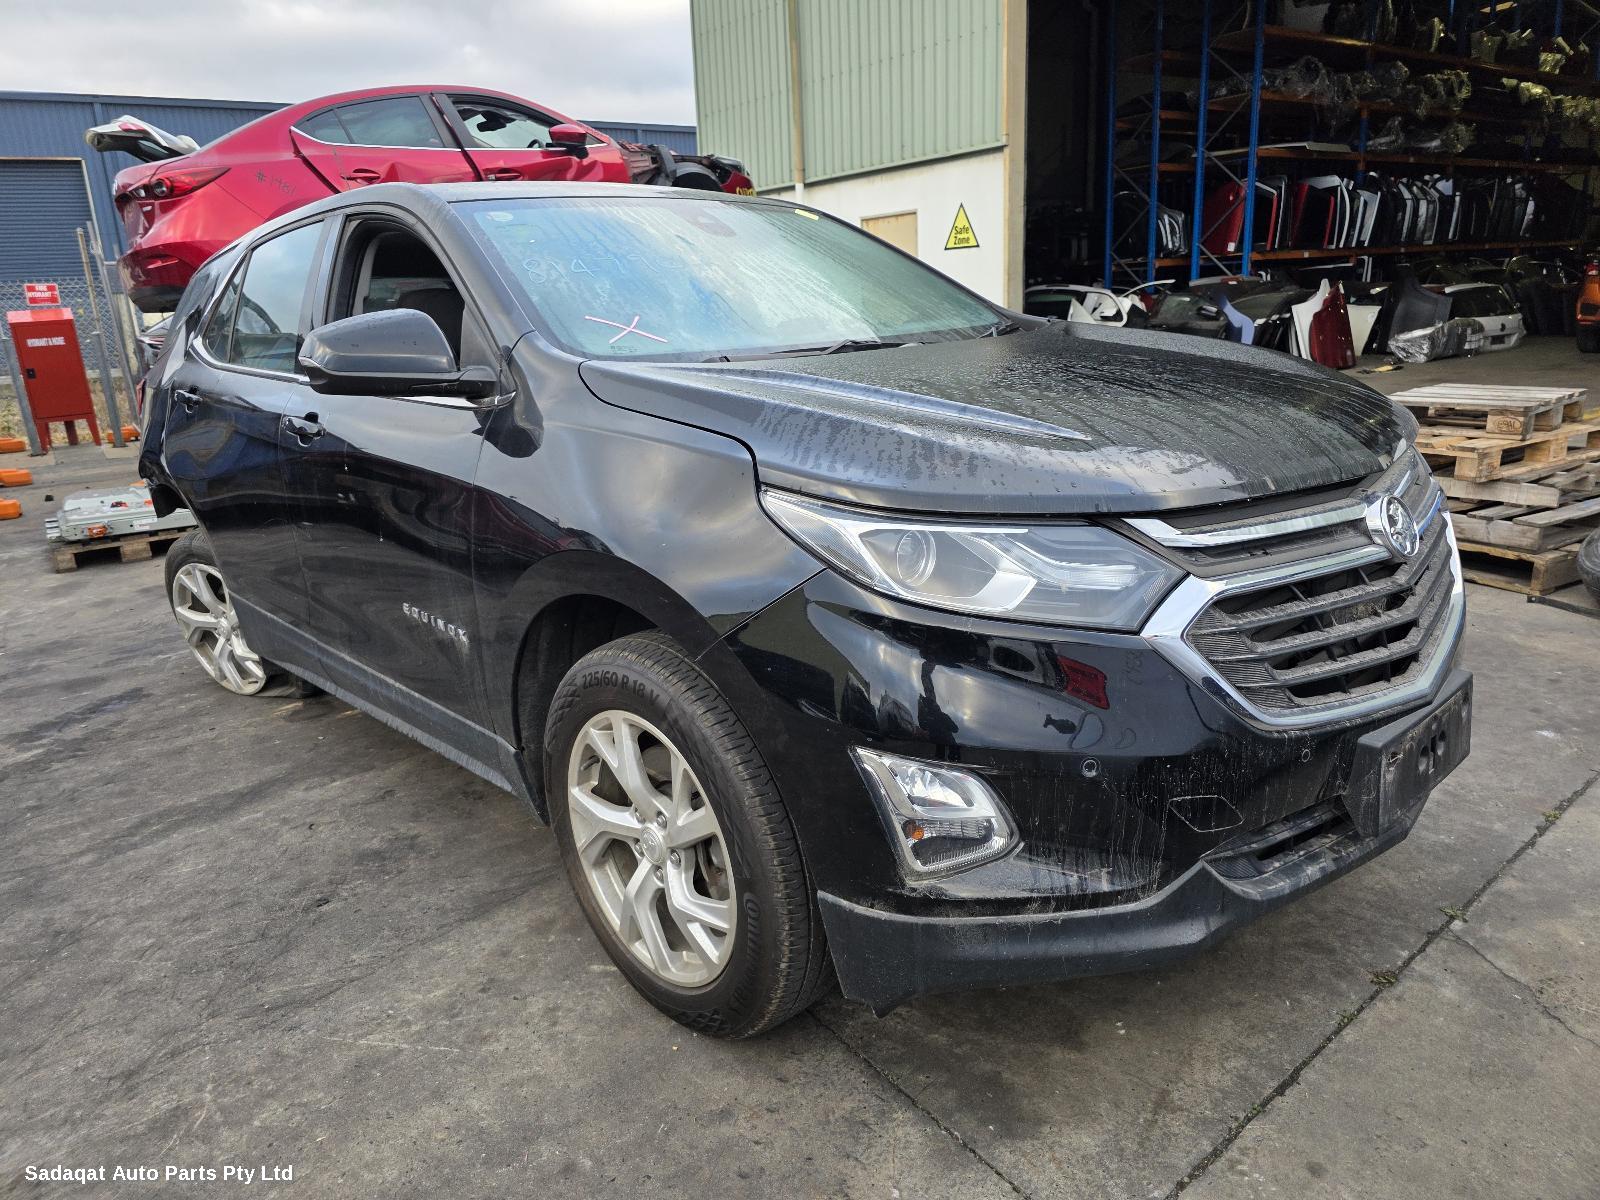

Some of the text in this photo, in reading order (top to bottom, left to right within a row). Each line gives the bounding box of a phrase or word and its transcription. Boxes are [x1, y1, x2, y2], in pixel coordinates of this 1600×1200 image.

[954, 225, 970, 235] Safe
[954, 236, 970, 245] Zone
[402, 602, 469, 645] EQUINOX
[582, 669, 619, 690] 225/60
[621, 673, 630, 689] R
[632, 679, 646, 698] 18
